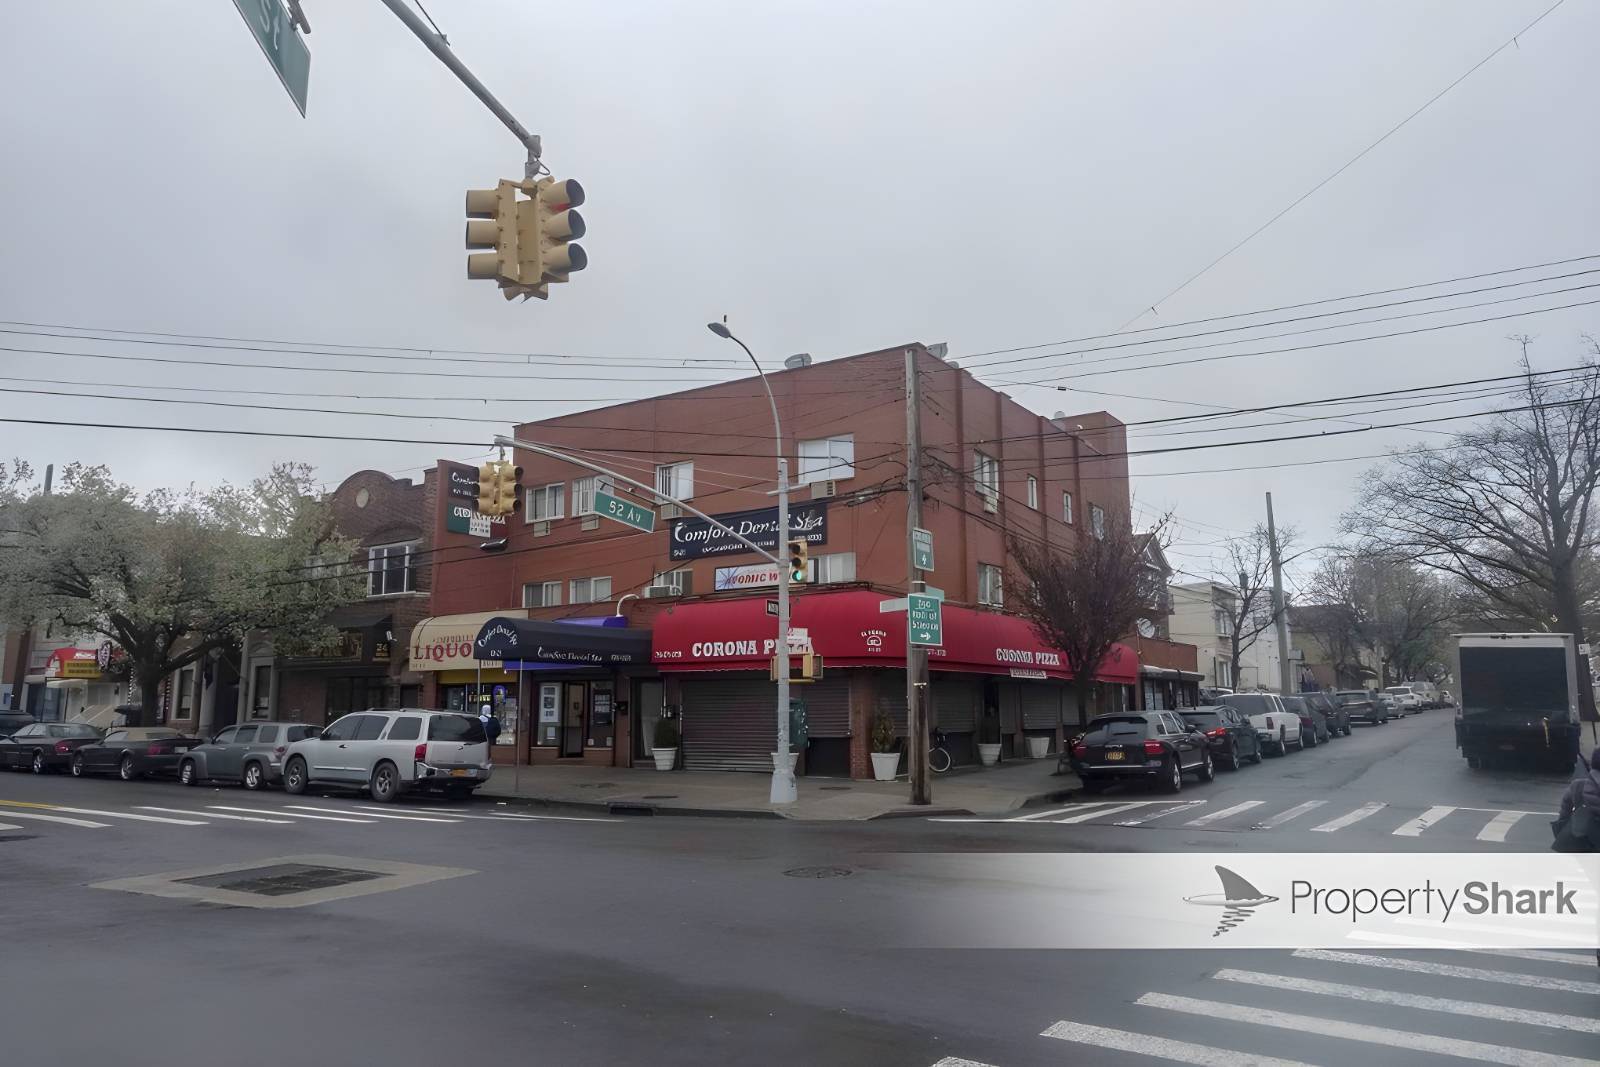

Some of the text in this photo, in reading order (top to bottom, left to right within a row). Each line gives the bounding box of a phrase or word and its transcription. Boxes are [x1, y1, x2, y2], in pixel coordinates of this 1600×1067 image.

[608, 500, 641, 522] 52 Av
[414, 642, 472, 662] LIQUO
[692, 640, 757, 657] CORONA
[1035, 652, 1060, 665] PIZZA
